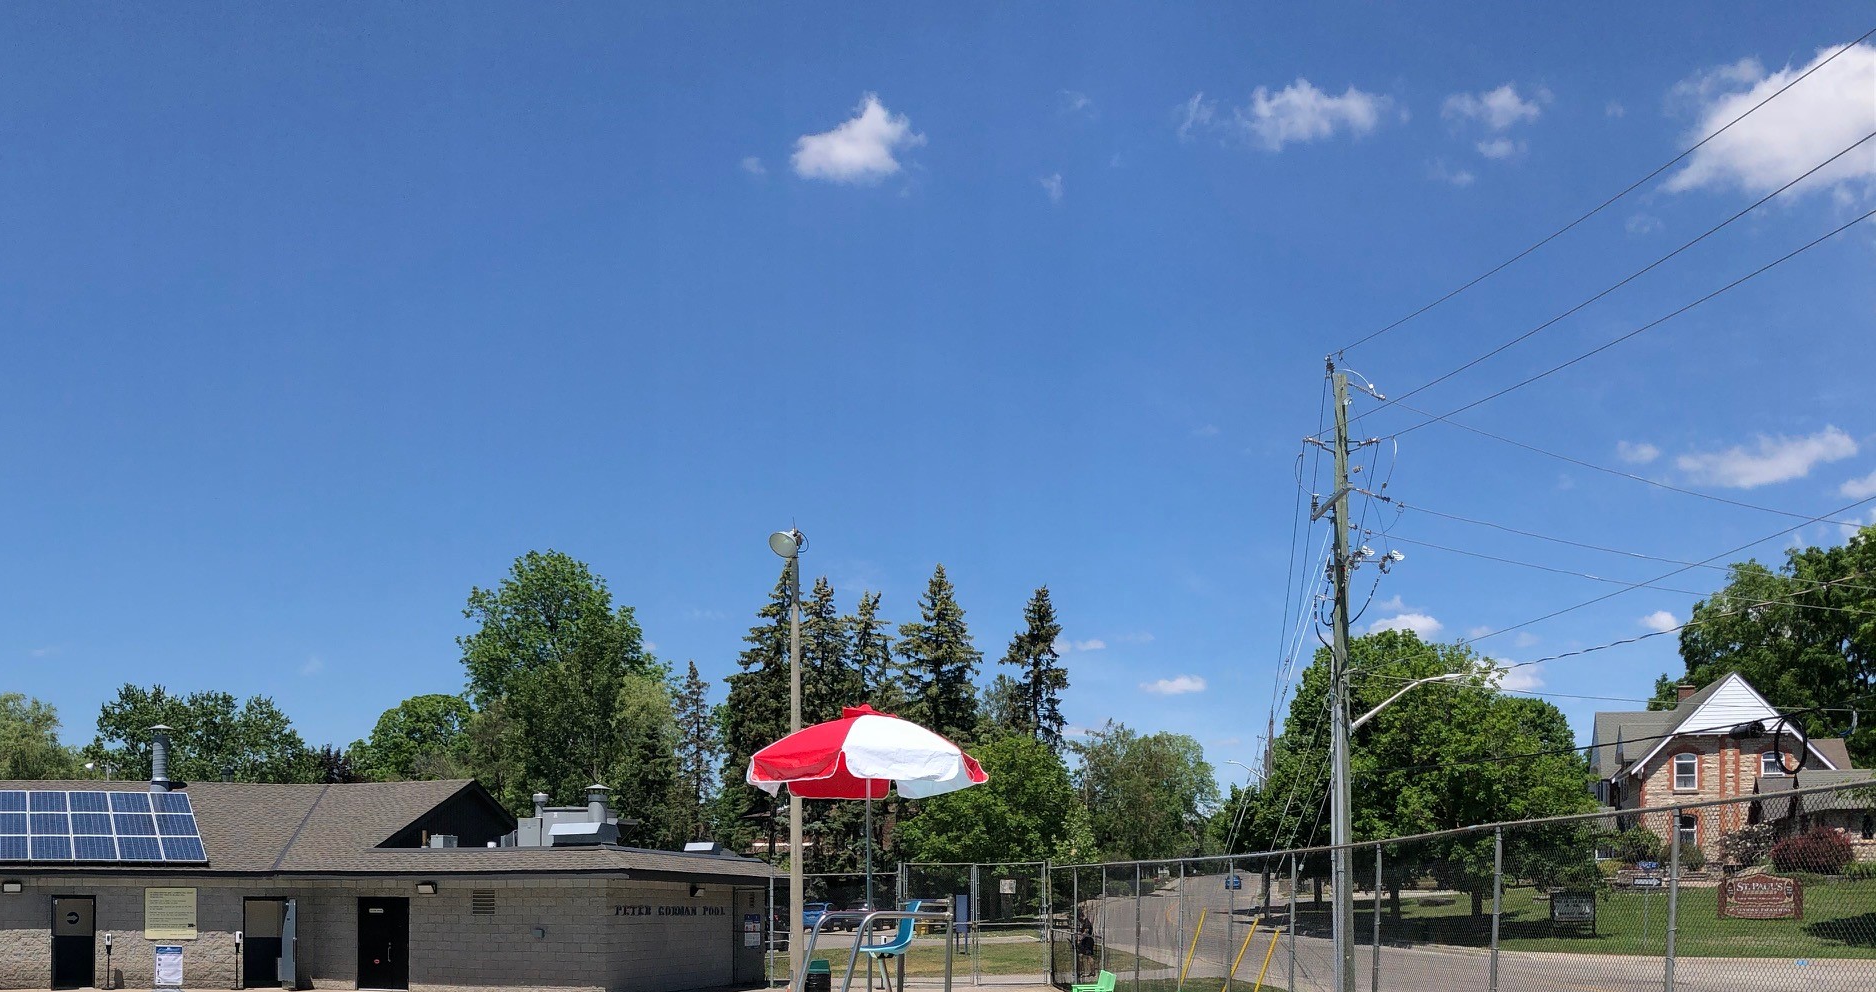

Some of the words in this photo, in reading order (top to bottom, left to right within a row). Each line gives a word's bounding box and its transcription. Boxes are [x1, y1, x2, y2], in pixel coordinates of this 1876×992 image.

[1752, 882, 1783, 891] PAUL'S
[614, 904, 652, 916] PETER
[658, 905, 697, 916] GORMAN
[702, 905, 726, 916] POOL
